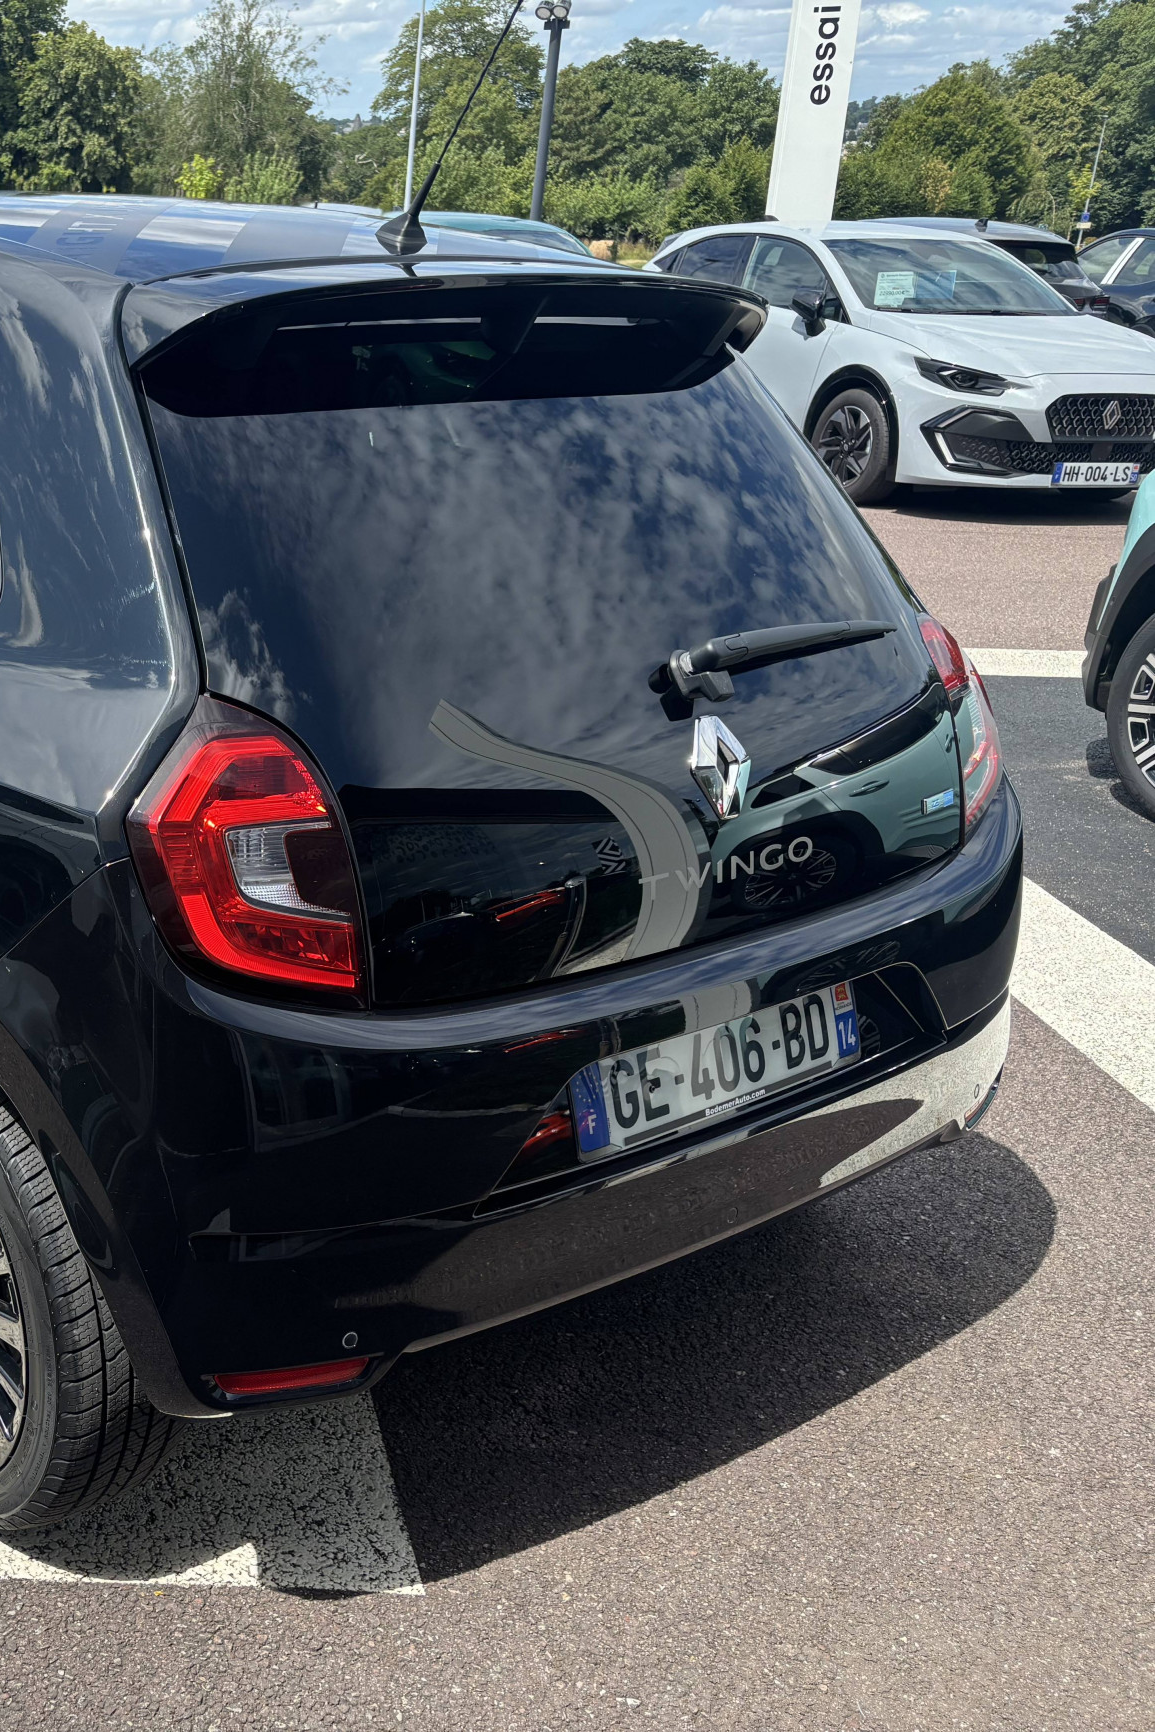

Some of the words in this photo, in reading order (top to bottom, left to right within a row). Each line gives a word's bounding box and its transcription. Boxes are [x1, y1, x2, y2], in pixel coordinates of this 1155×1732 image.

[810, 6, 841, 105] essai
[1062, 466, 1131, 482] HH-004-LS
[638, 836, 814, 900] TWINGO
[838, 1018, 856, 1050] 14
[610, 993, 830, 1130] GE-406-BD
[705, 1089, 766, 1116] BodemerAuto.com
[587, 1114, 596, 1135] F
